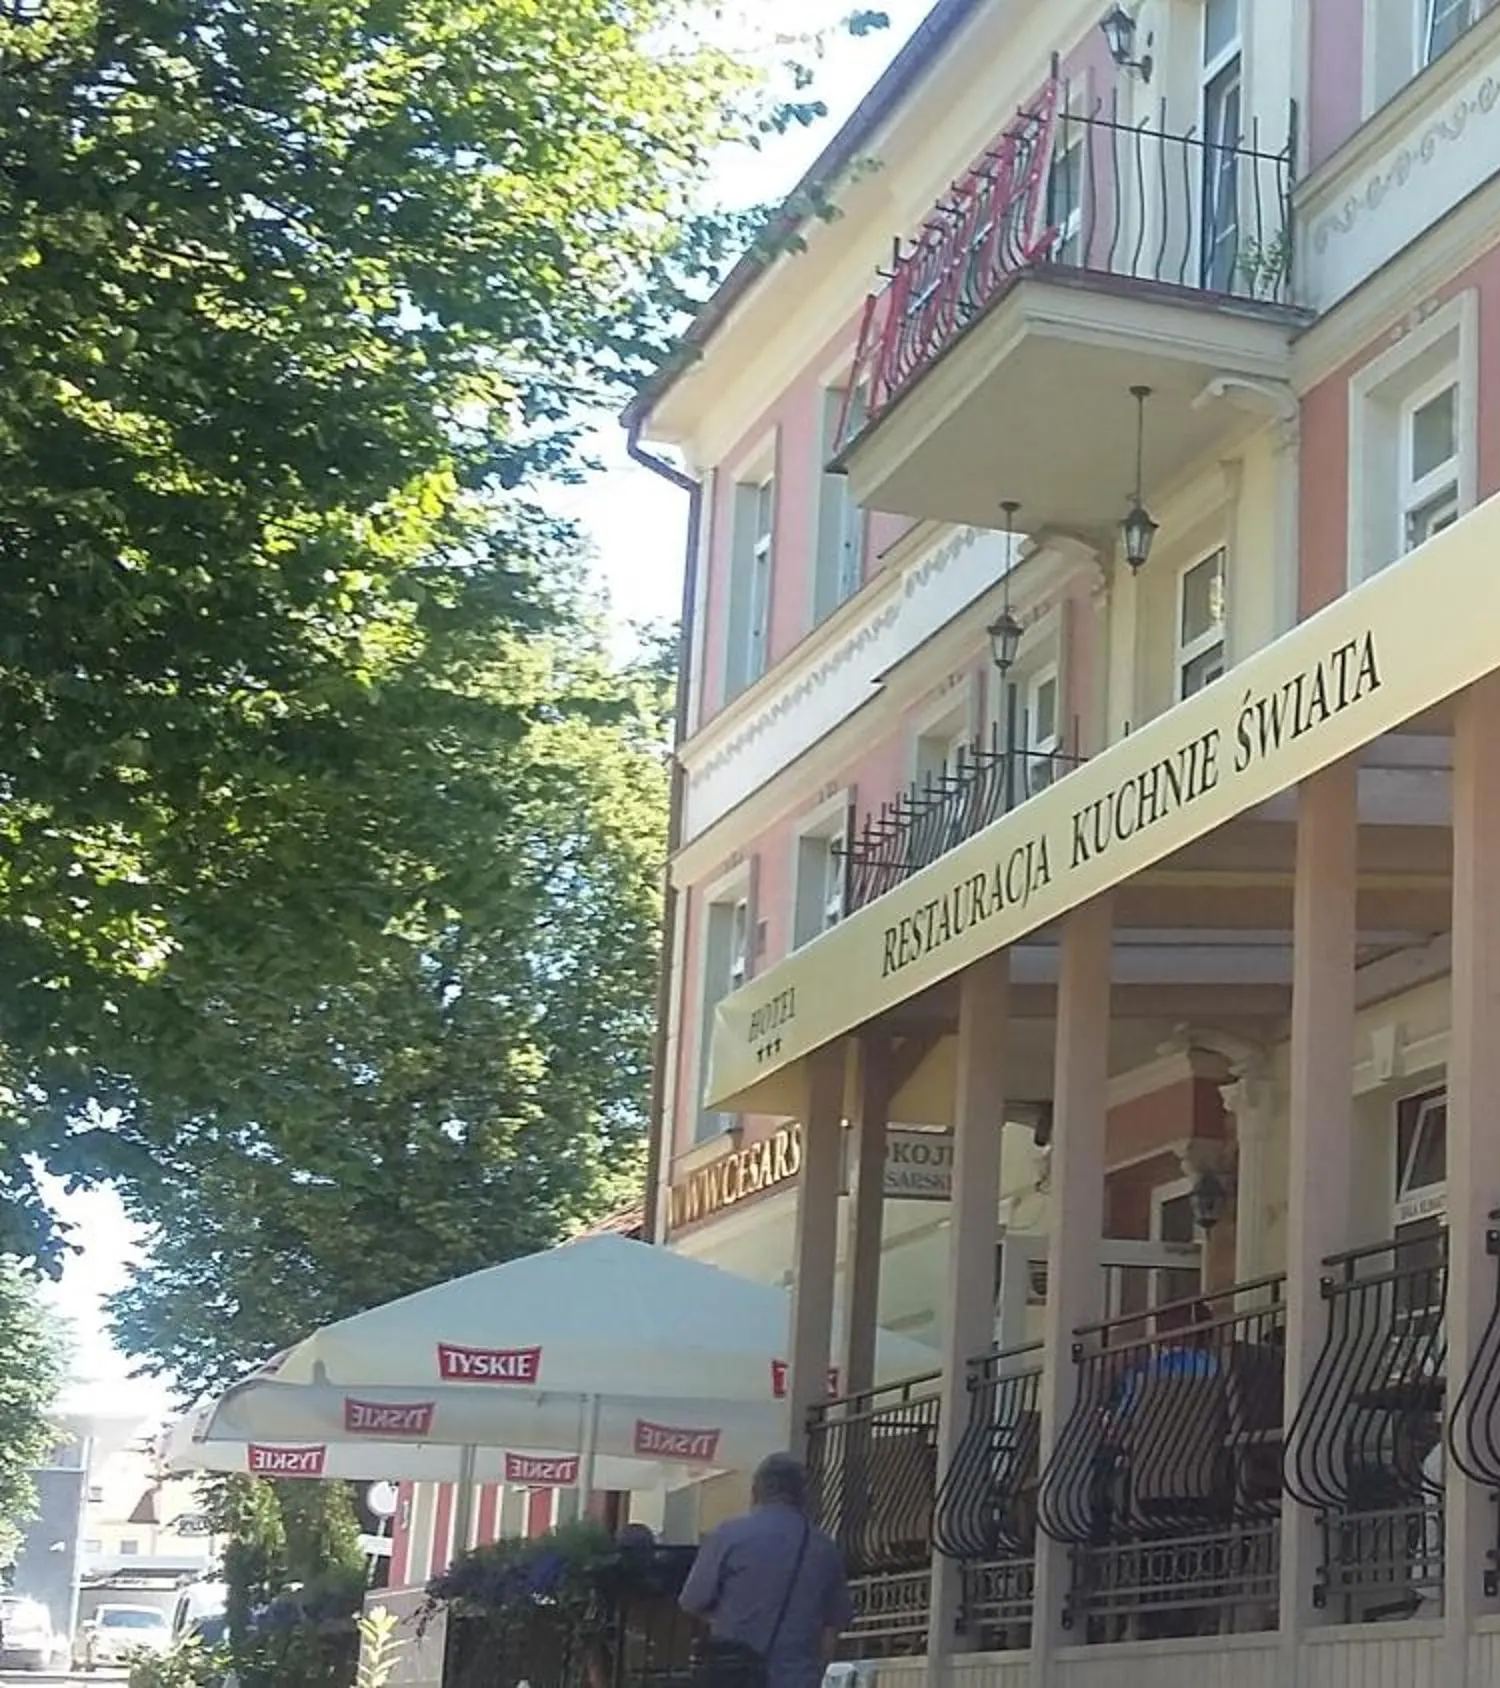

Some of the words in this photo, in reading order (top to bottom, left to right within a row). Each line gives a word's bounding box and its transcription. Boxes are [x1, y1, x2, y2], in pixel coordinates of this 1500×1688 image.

[882, 834, 1051, 977] RESTAURACJA
[1070, 729, 1220, 868] KUCHNIE
[1234, 630, 1382, 772] ŚWIATA
[748, 987, 796, 1043] HOTEL
[443, 1350, 533, 1377] TYSKIE
